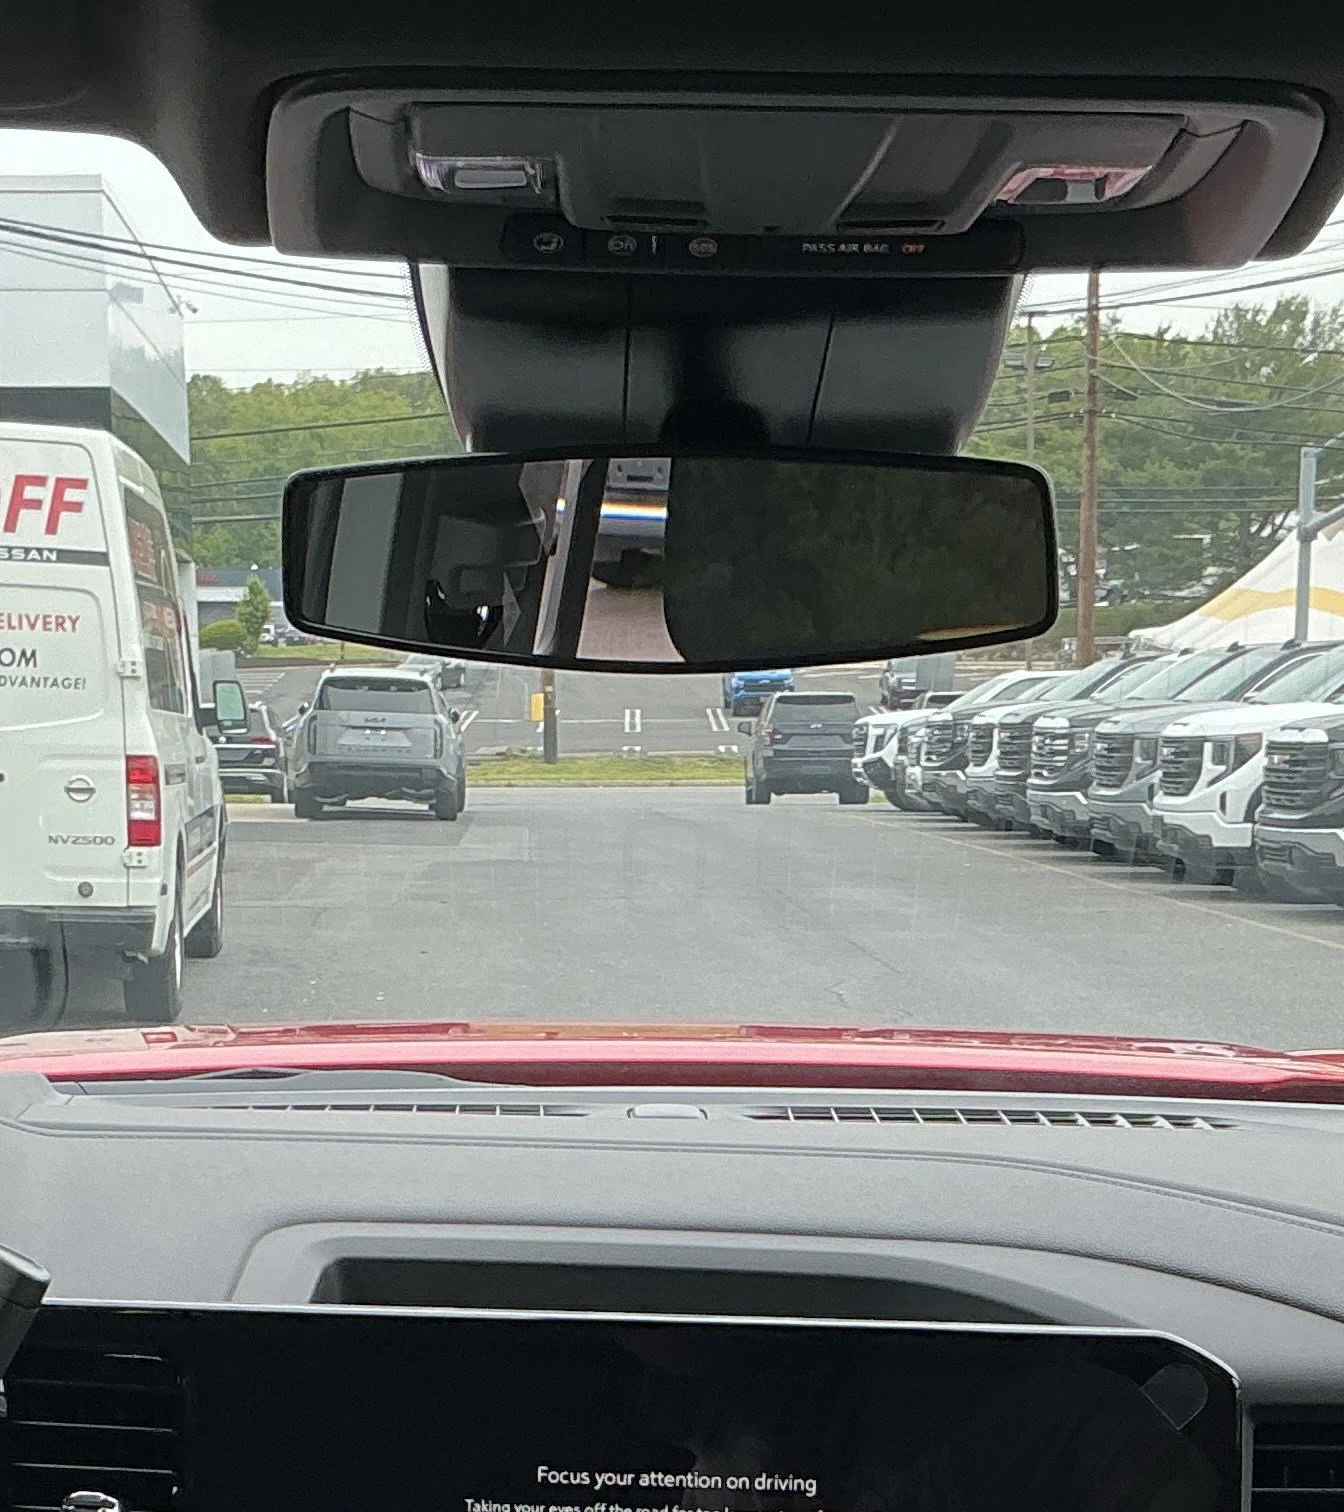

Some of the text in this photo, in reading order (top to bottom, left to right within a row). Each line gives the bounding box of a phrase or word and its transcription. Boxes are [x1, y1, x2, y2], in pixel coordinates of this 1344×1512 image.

[801, 242, 835, 254] PASS
[837, 242, 860, 254] AIR
[48, 834, 116, 845] NV2500
[537, 1466, 817, 1498] Focus your attention on driving
